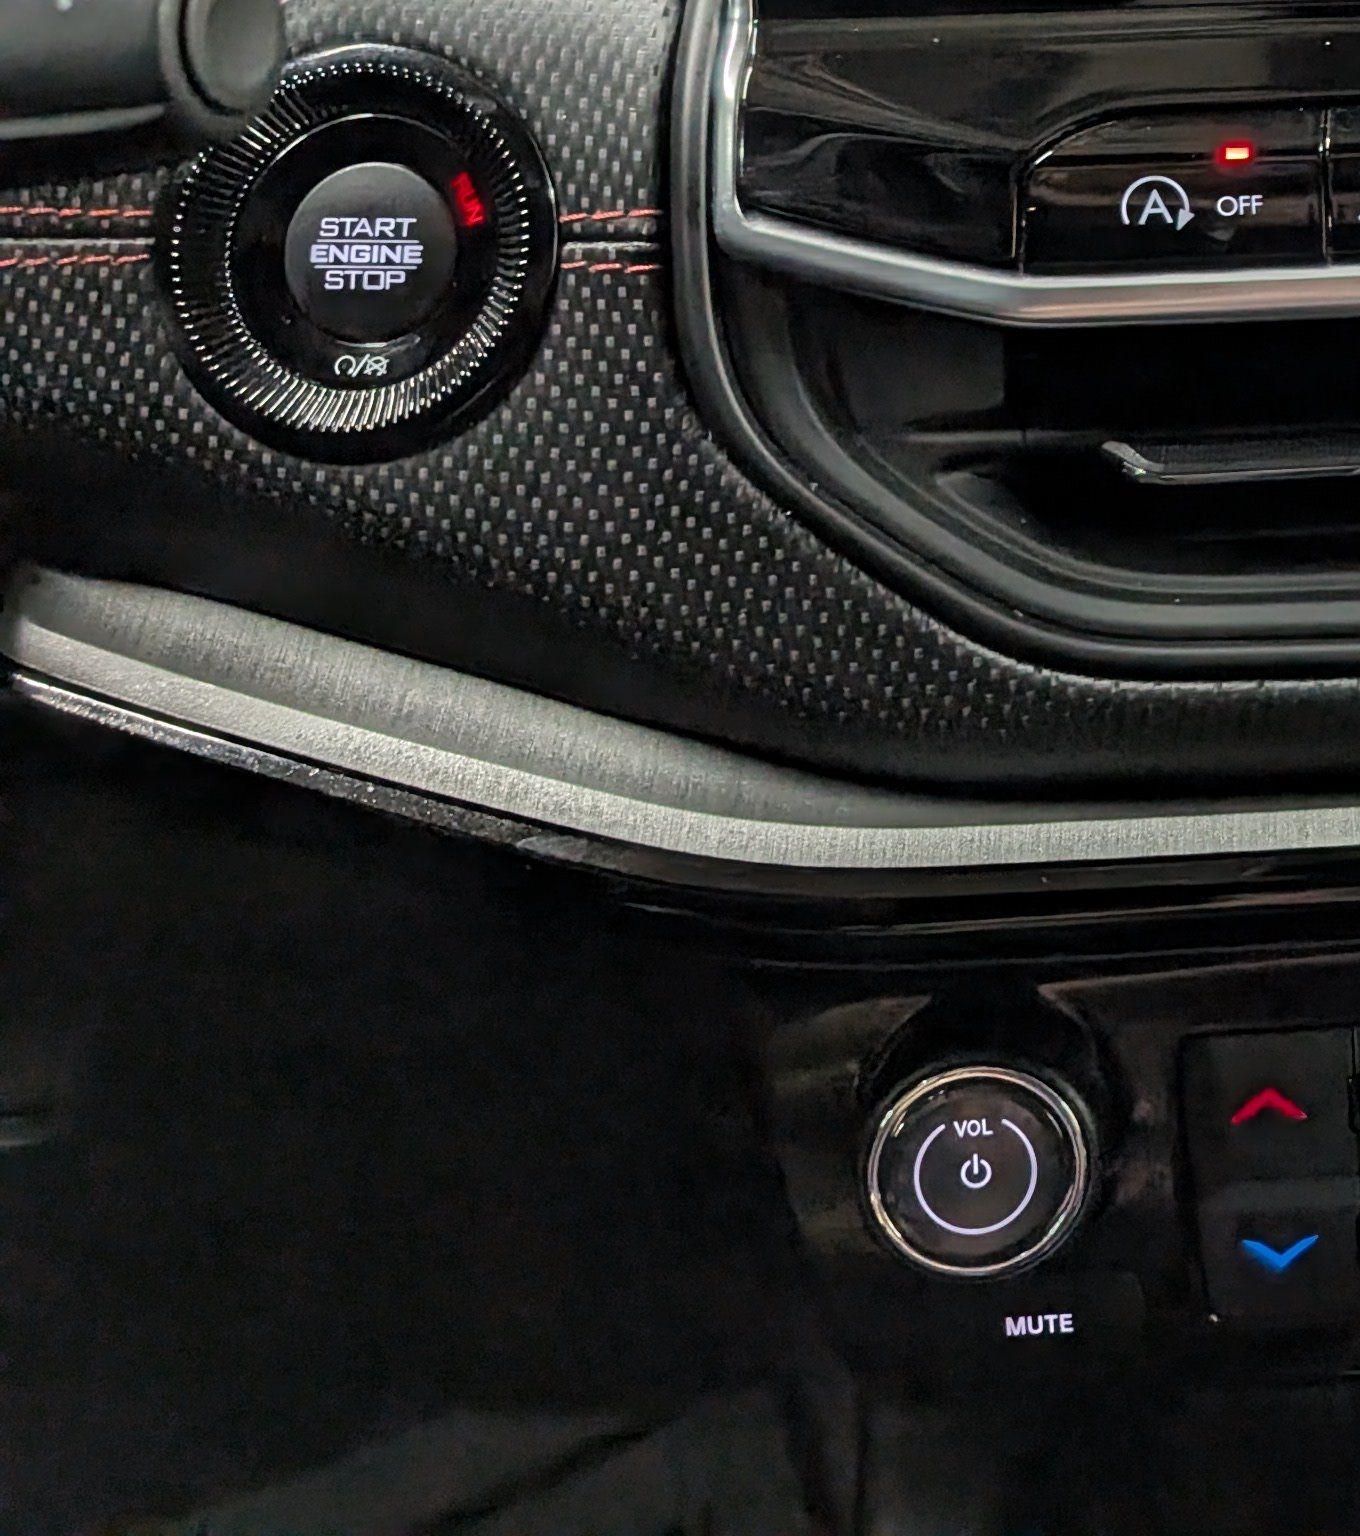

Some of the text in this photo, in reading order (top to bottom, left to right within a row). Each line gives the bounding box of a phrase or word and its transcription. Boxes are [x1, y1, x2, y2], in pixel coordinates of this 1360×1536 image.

[1216, 194, 1263, 217] OFF
[319, 217, 417, 238] START
[309, 244, 424, 265] ENGINE
[324, 269, 407, 291] STOP
[953, 1118, 994, 1139] VOL
[1005, 1313, 1075, 1338] MUTE
